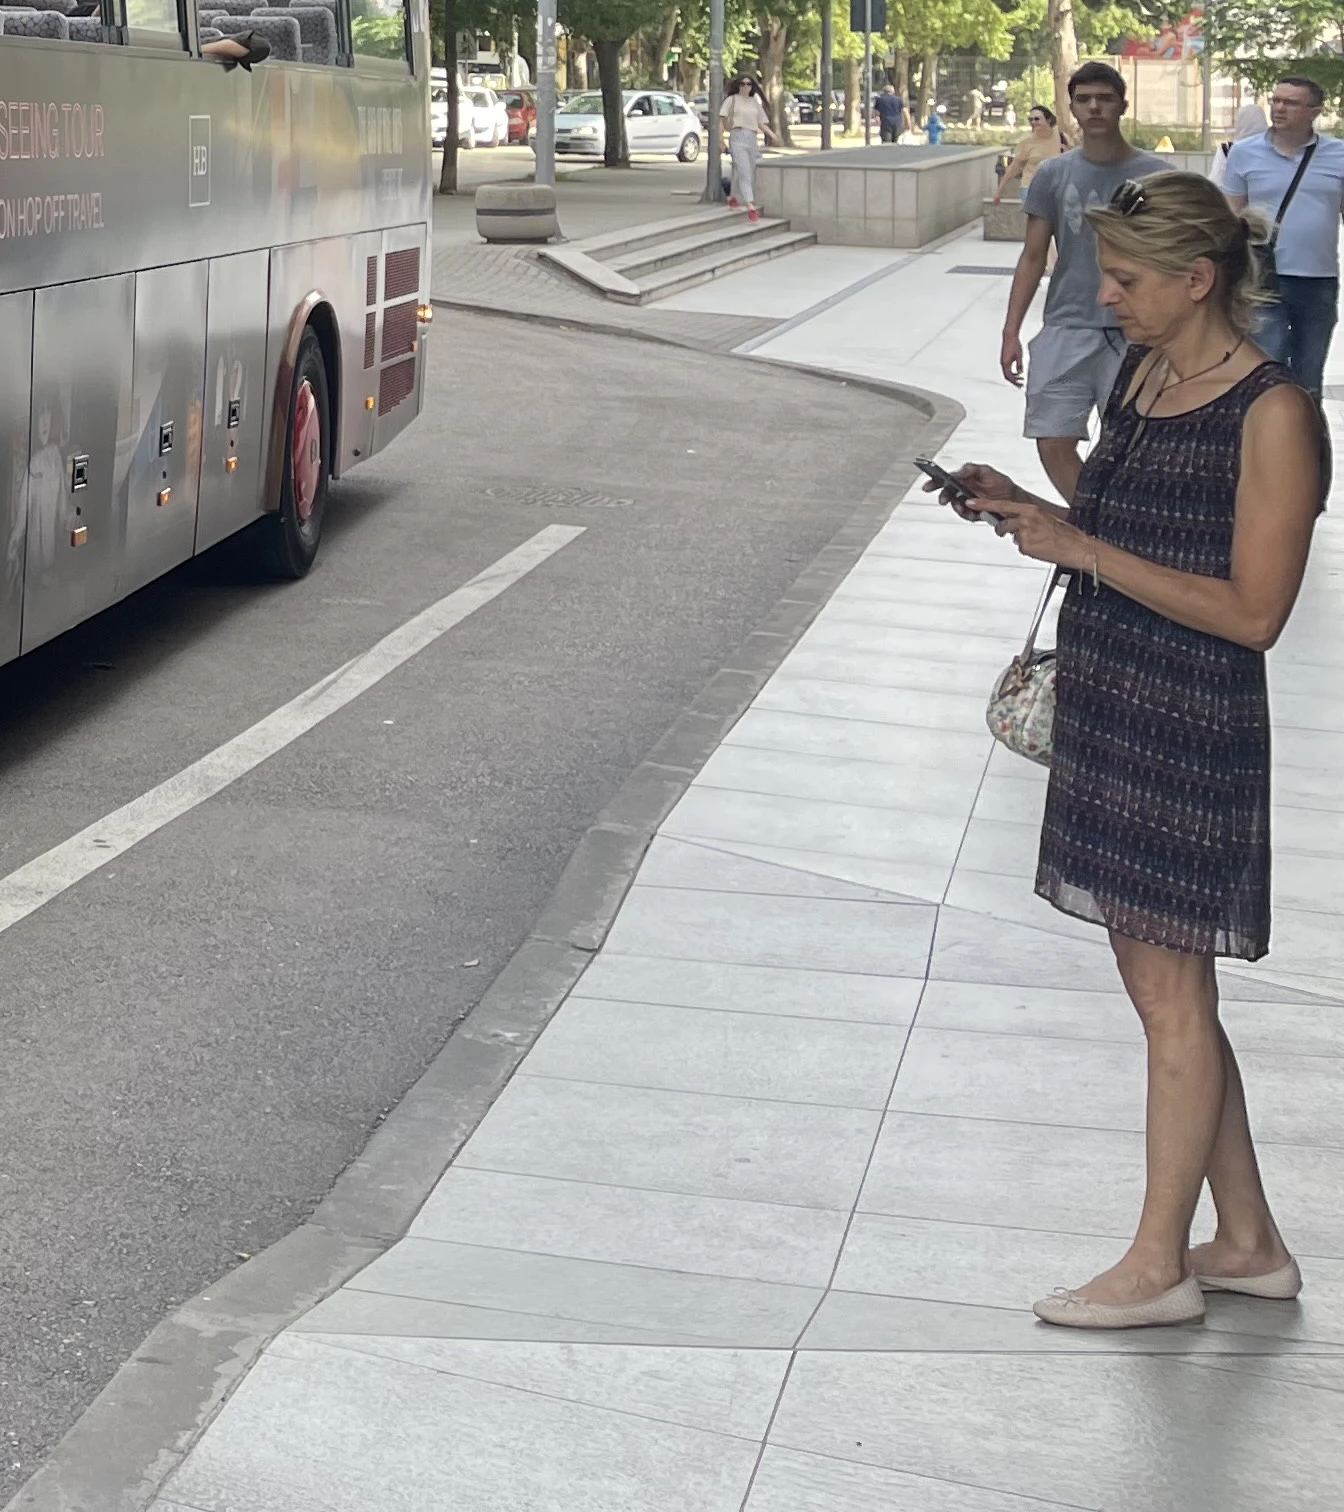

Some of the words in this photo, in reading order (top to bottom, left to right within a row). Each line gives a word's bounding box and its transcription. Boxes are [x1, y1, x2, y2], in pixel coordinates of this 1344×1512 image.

[61, 103, 105, 158] TOUR
[17, 196, 42, 237] HOP
[44, 195, 65, 234] OFF
[66, 192, 105, 231] TRAVEL
